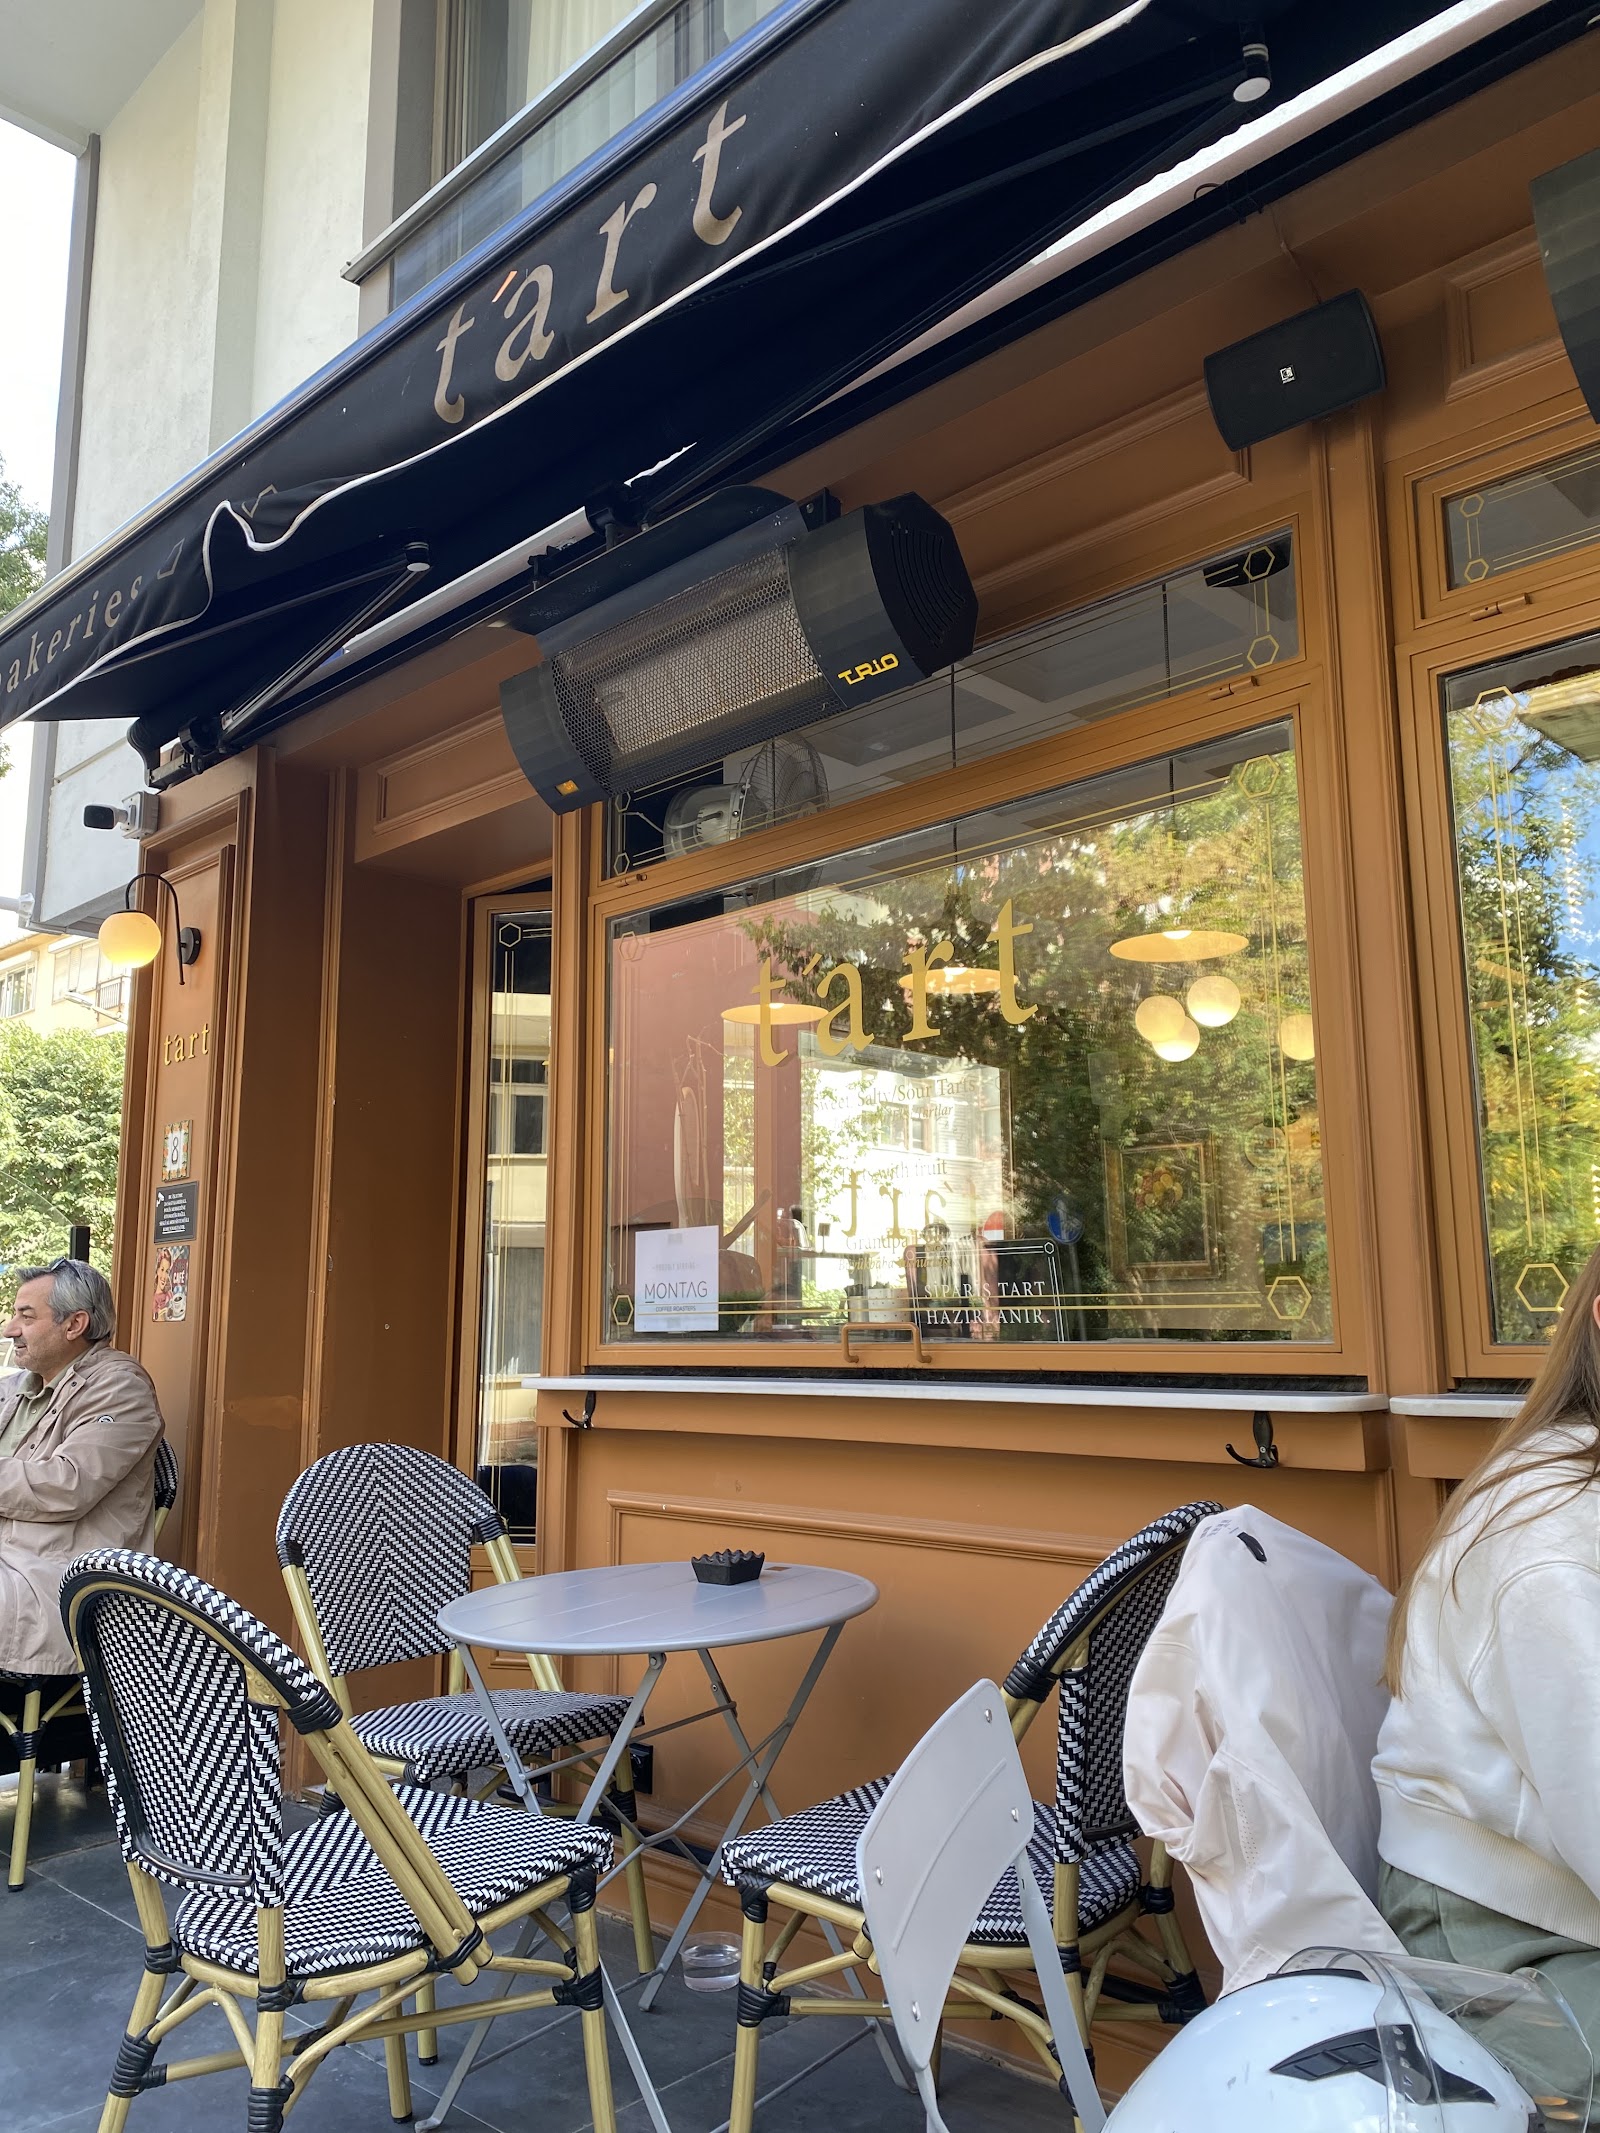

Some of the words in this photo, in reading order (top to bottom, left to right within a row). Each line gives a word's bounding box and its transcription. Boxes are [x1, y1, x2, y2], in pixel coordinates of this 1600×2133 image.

[937, 1079, 976, 1097] Tarts
[644, 1280, 708, 1300] MONTAG
[998, 1280, 1046, 1297] TART
